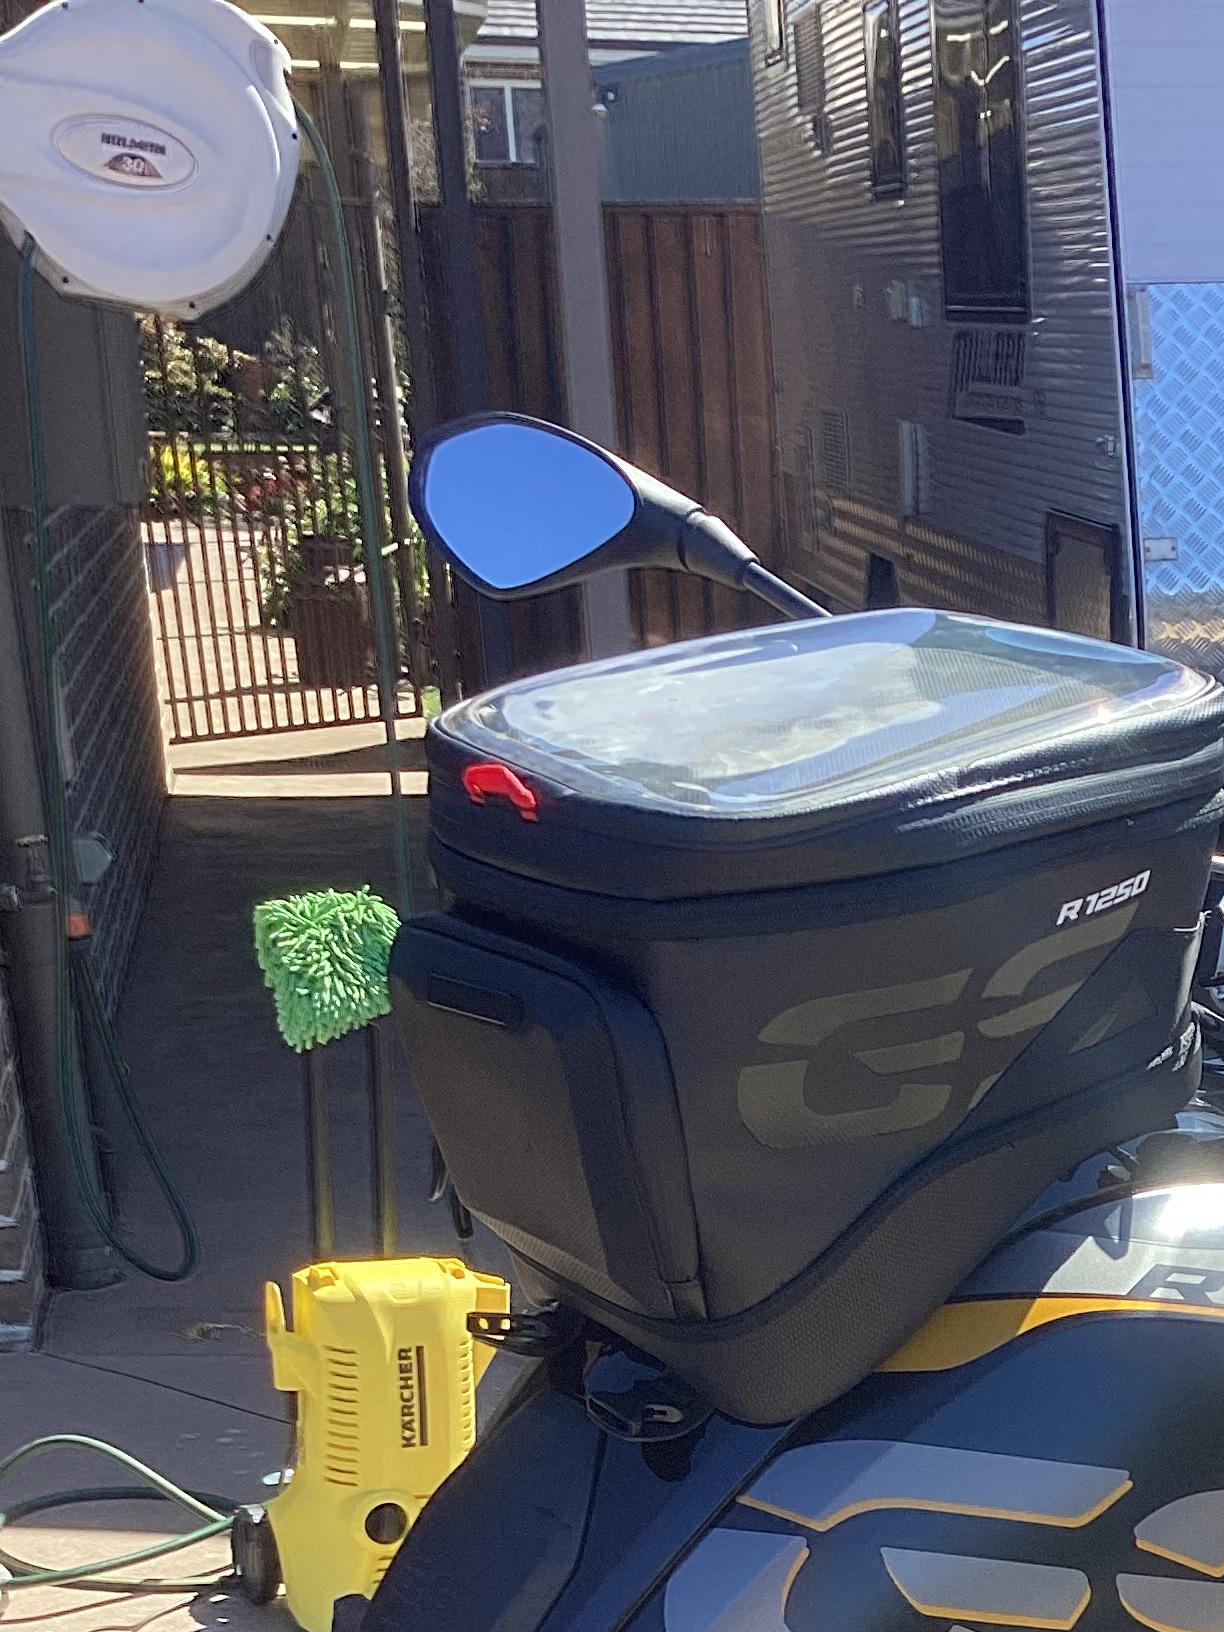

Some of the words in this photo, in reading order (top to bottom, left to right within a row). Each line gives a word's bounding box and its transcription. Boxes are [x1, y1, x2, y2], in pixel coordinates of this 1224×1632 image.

[1056, 898, 1084, 926] R
[1085, 869, 1151, 915] 1250
[398, 1346, 417, 1448] KÄRCHER
